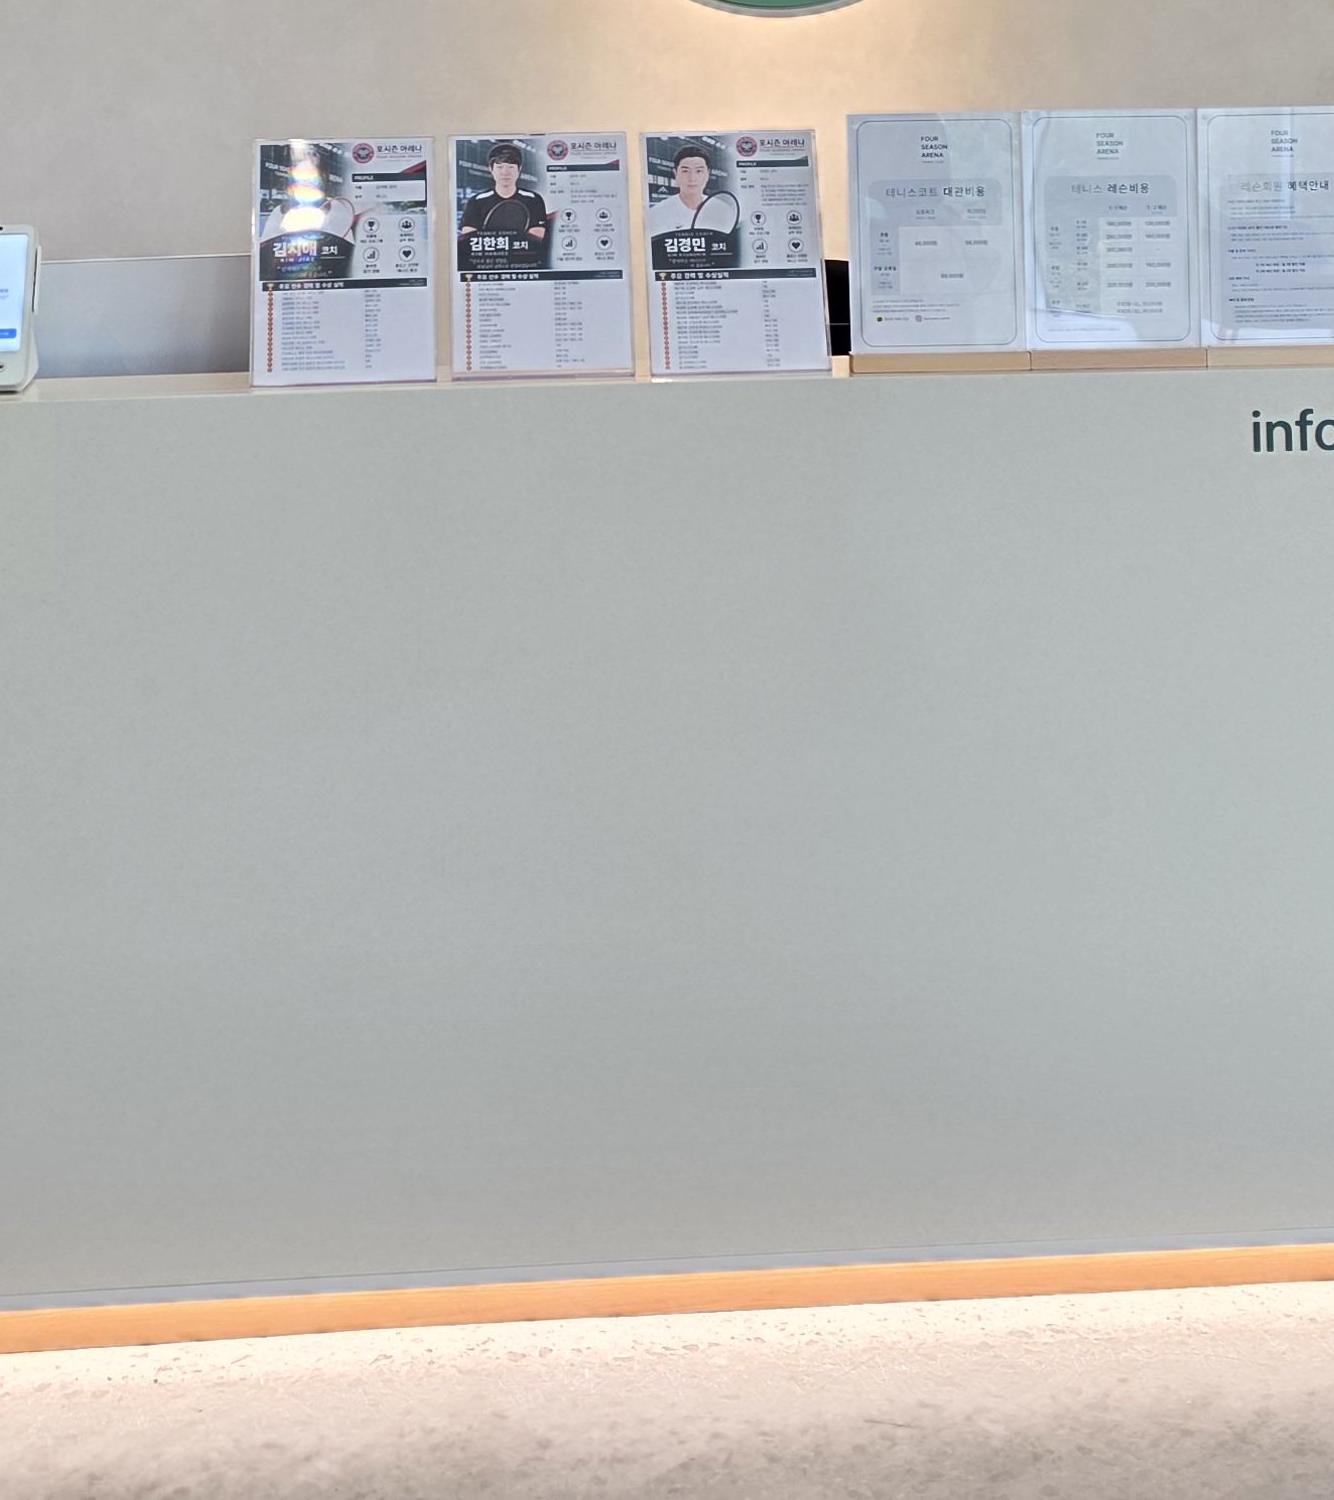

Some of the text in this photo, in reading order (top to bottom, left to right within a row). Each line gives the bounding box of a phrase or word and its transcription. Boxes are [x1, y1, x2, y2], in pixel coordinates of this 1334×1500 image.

[570, 141, 617, 150] 포시즌 아레나
[759, 138, 805, 147] 포시즌 아레나
[1071, 182, 1150, 194] 테니스 레슨비용
[1287, 180, 1329, 191] 혜택안내
[885, 186, 986, 198] 테니스코트 대관비용
[469, 236, 529, 251] 김한희 코치
[664, 237, 727, 252] 김경민 코치
[321, 245, 338, 255] 코치
